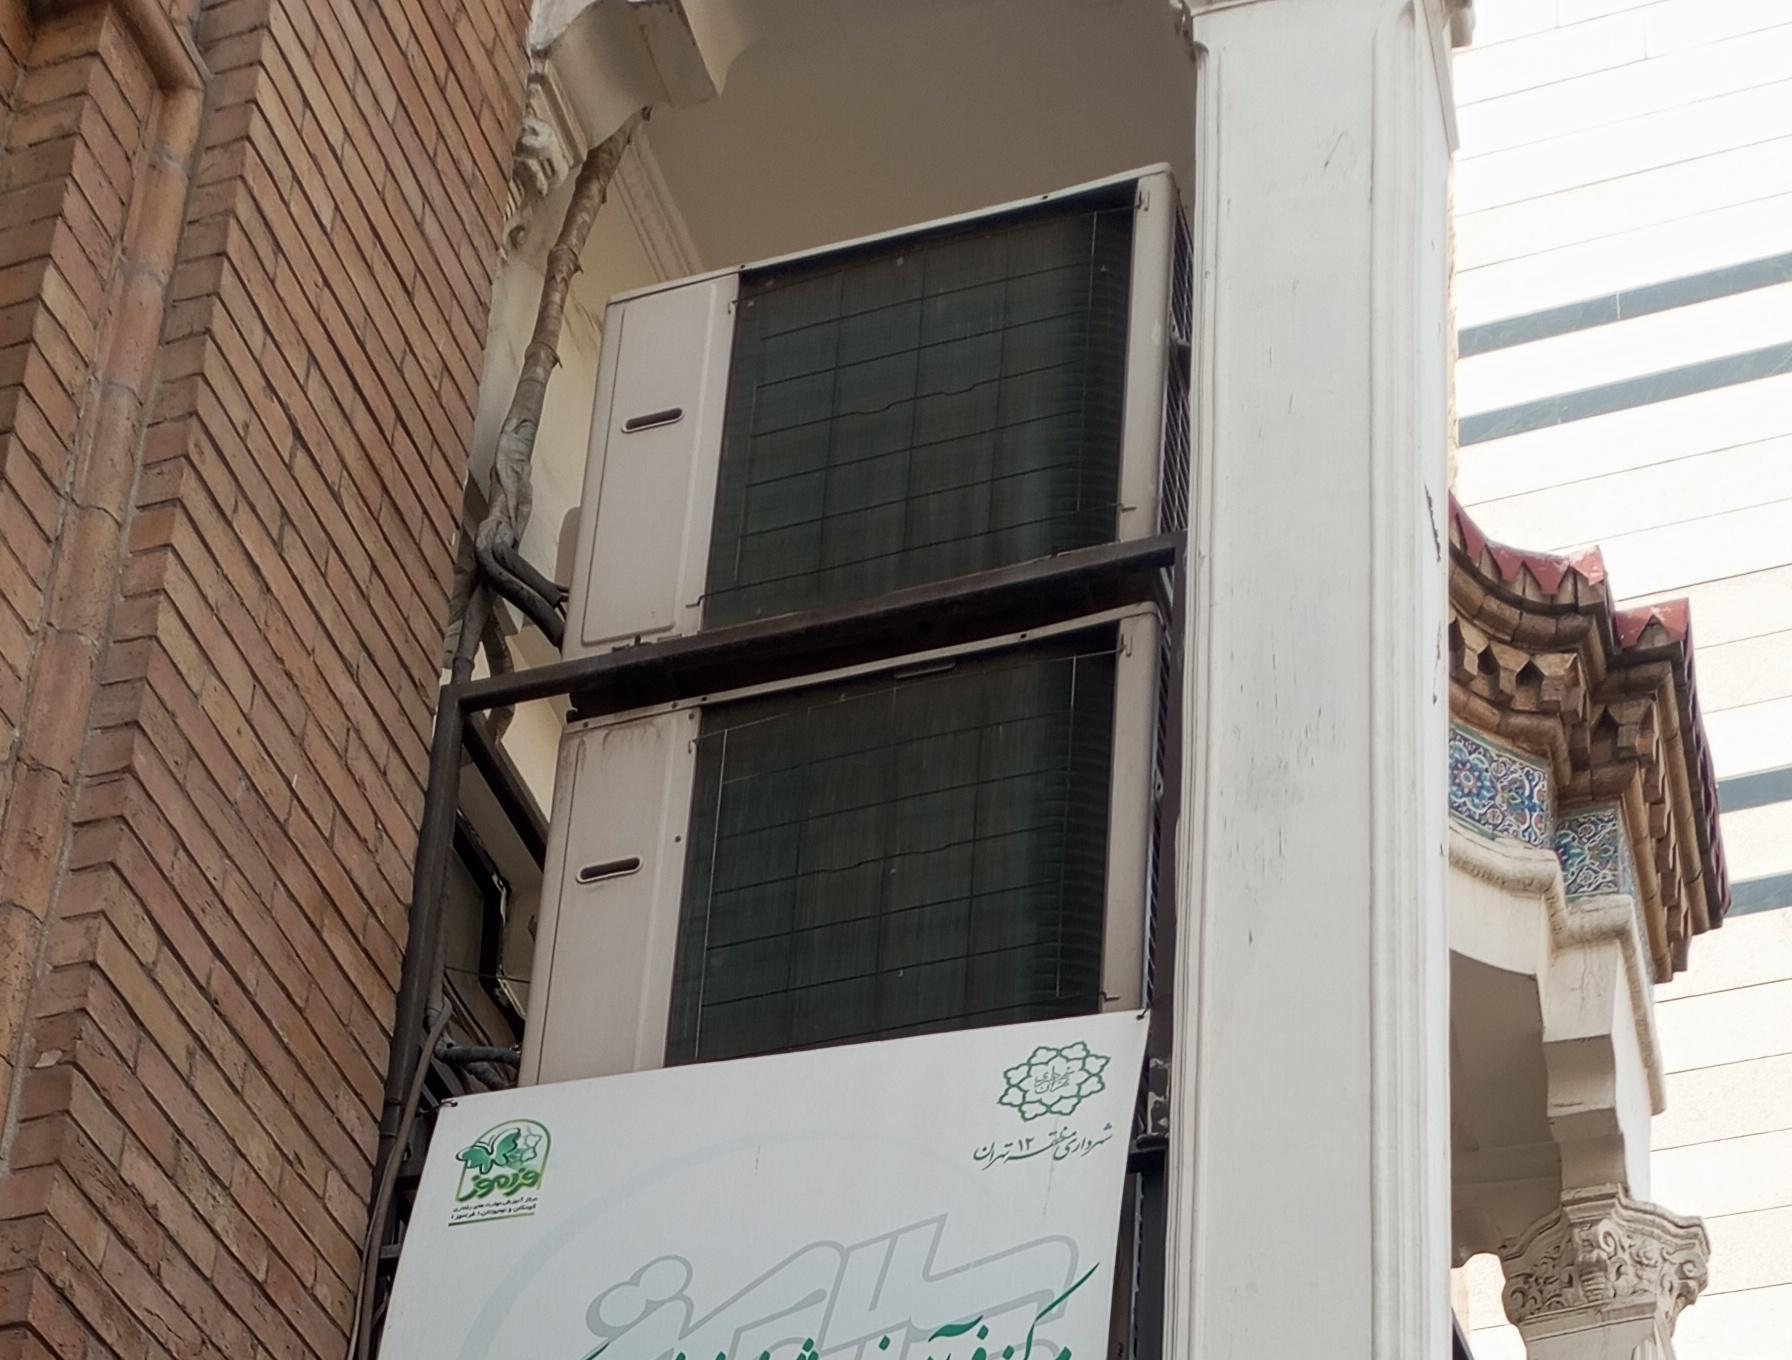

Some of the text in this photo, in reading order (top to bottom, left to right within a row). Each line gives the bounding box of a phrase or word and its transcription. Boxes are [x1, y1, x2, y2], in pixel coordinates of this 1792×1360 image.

[973, 1122, 1112, 1171] شهرداری منطقه ۱۲ تهران
